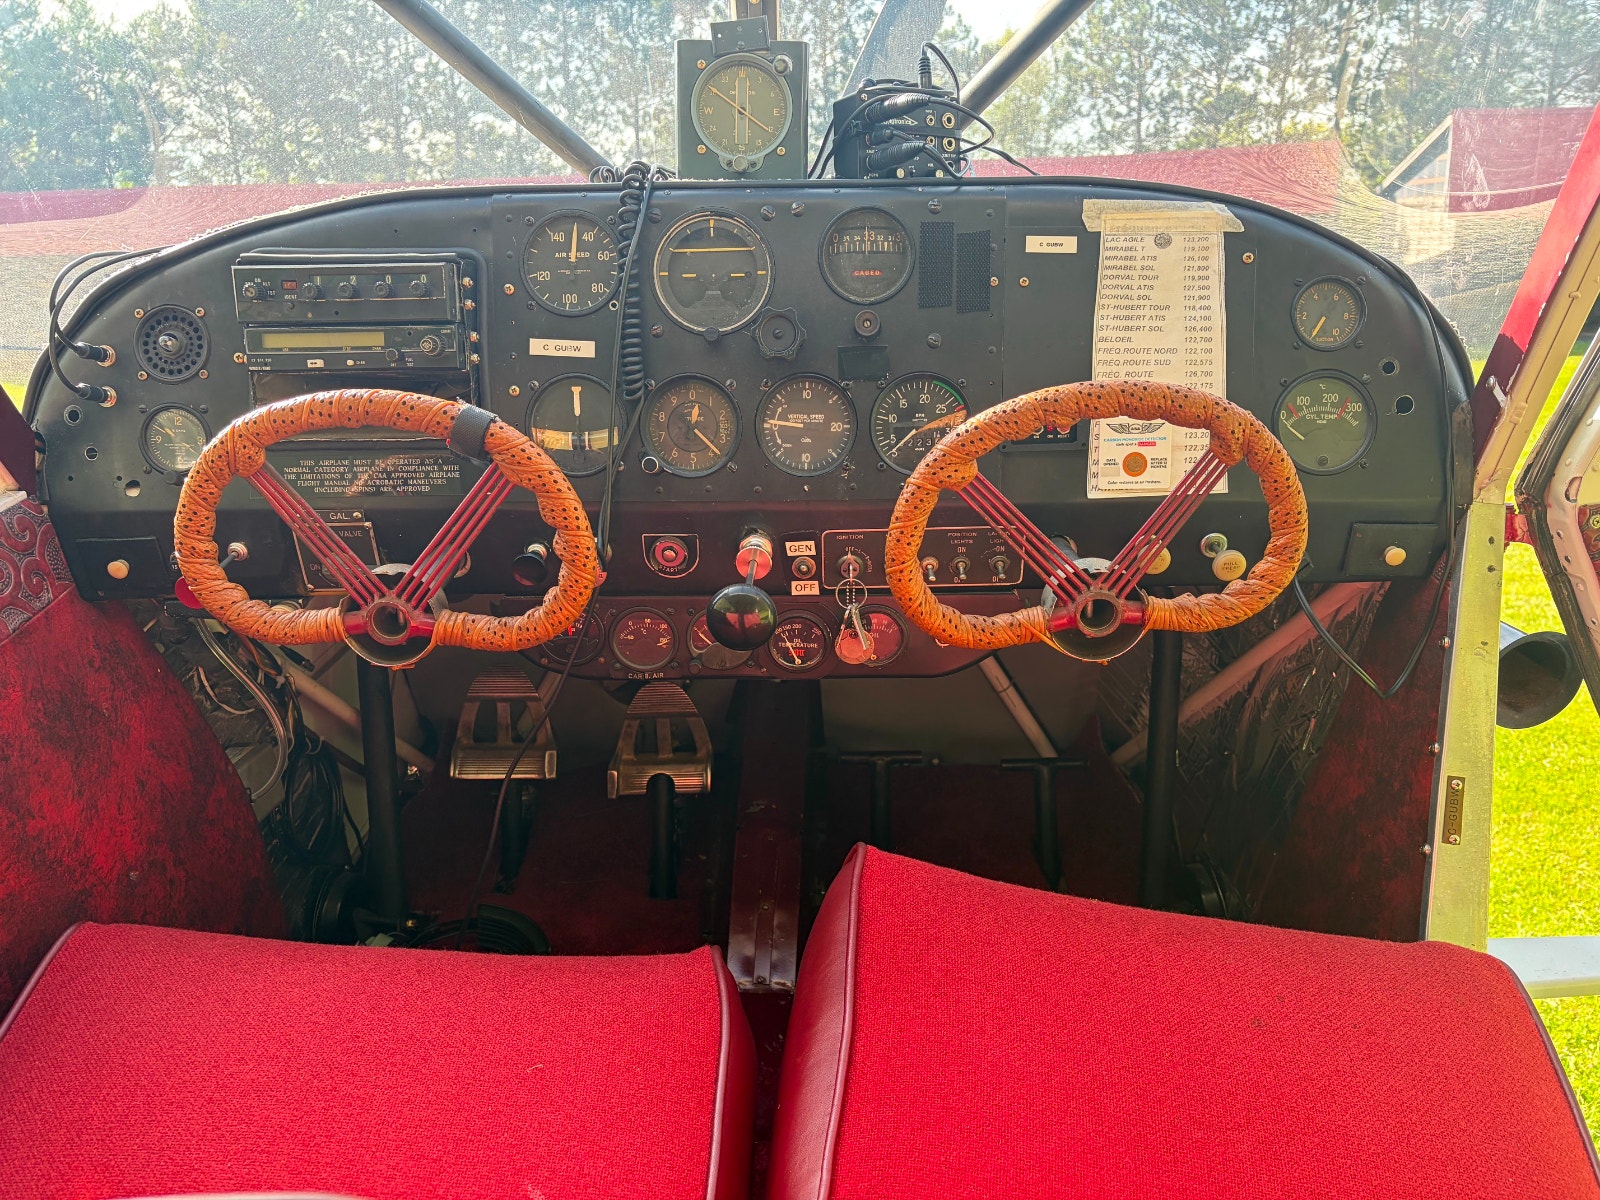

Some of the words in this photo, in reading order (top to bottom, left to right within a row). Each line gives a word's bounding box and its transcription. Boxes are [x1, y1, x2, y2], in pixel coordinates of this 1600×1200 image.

[704, 107, 714, 115] W
[551, 231, 565, 242] 140
[582, 231, 594, 242] 40
[597, 251, 610, 261] 60
[350, 275, 357, 285] 2
[385, 274, 391, 285] 0
[421, 274, 427, 284] 0
[537, 271, 551, 281] 120
[591, 283, 604, 293] 80
[562, 294, 578, 303] 100
[1313, 293, 1319, 301] 4
[1333, 293, 1339, 301] 6
[1302, 311, 1307, 320] 2
[1343, 312, 1349, 320] 8
[1332, 328, 1340, 336] 10
[1098, 335, 1134, 343] BELOEIL
[1184, 336, 1213, 344] 122,700
[554, 344, 582, 352] GUBW
[1153, 347, 1178, 355] NORD
[1184, 347, 1213, 355] 122,100
[1096, 370, 1122, 379] FRÉQ.
[1124, 370, 1154, 378] ROUTE
[689, 389, 696, 400] 0
[802, 390, 812, 399] 10
[919, 394, 931, 404] 20
[1322, 393, 1339, 403] 200
[671, 396, 677, 406] 9
[899, 399, 908, 409] 15
[1296, 396, 1311, 406] 100
[935, 404, 947, 414] 25
[1345, 402, 1363, 412] 300
[659, 411, 665, 422] 8
[719, 410, 726, 420] 2
[888, 414, 897, 423] 10
[1280, 410, 1287, 420] 0
[174, 416, 183, 426] 12
[830, 422, 843, 432] 20
[155, 435, 162, 443] 9
[197, 437, 203, 445] 3
[659, 431, 665, 442] 7
[720, 433, 726, 444] 3
[891, 434, 897, 444] 5
[671, 447, 679, 458] 6
[690, 453, 697, 464] 5
[801, 453, 811, 463] 10
[789, 544, 813, 553] GEN
[658, 565, 678, 573] START
[795, 584, 816, 592] OFF
[1447, 789, 1460, 835] C-GUBW
